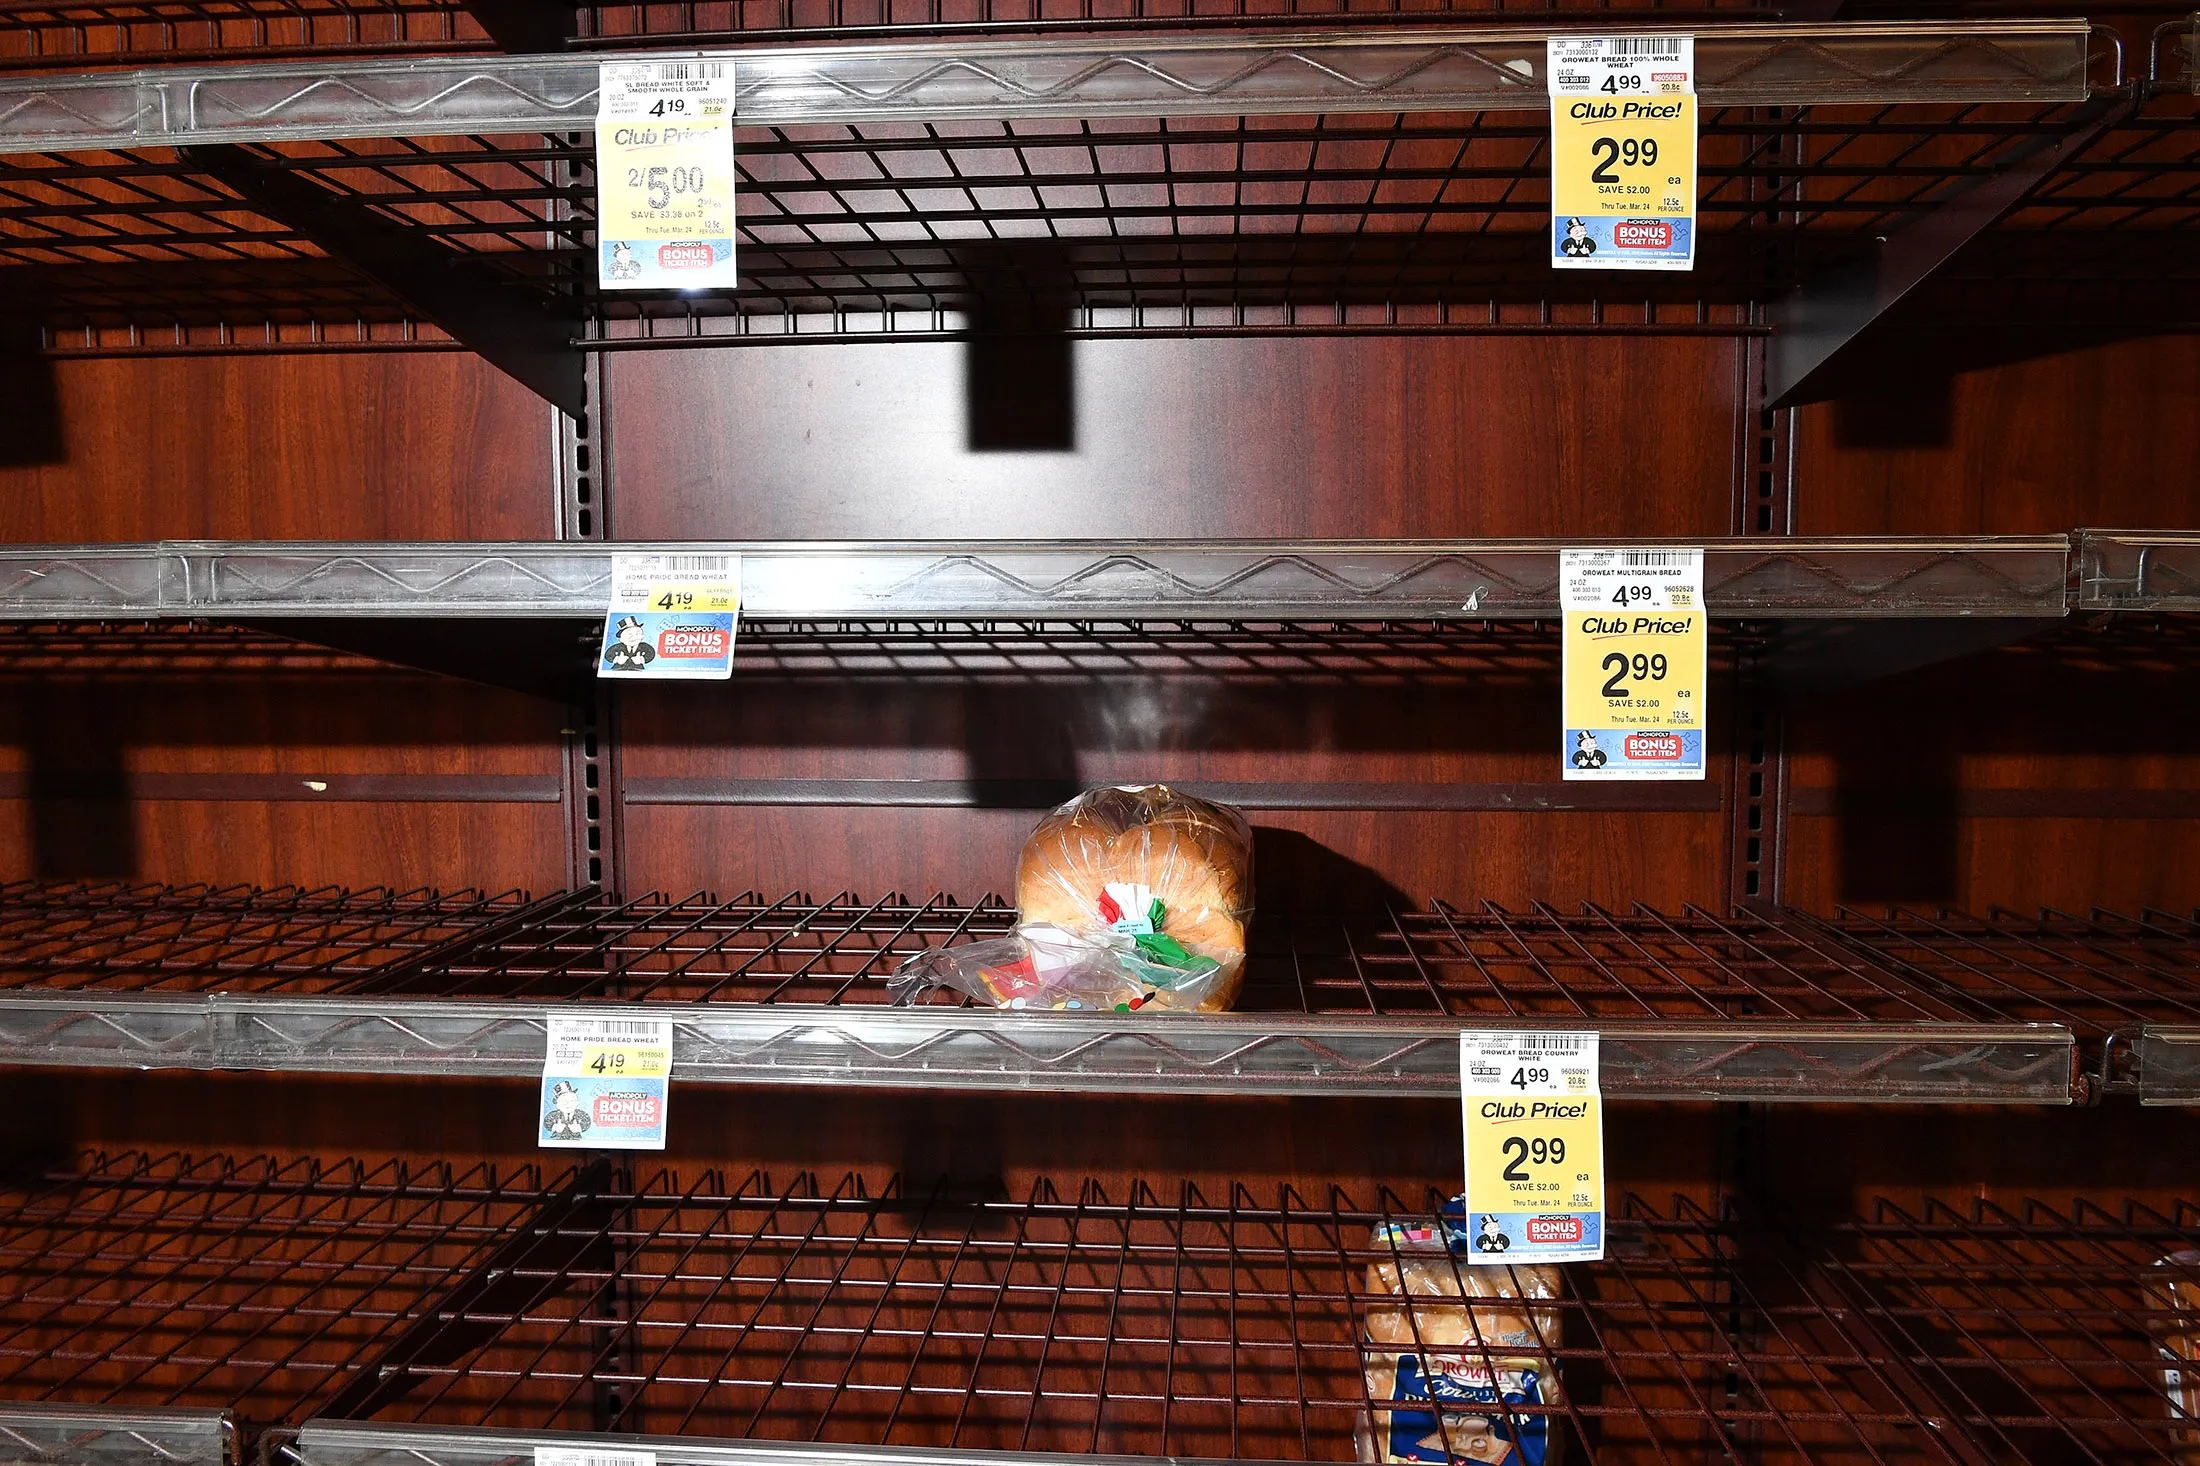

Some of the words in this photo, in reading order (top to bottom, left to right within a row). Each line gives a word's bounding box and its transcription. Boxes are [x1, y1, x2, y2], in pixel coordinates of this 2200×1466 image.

[1600, 75, 1641, 94] 499
[1570, 102, 1617, 118] Club
[1622, 102, 1682, 118] Price!
[615, 129, 657, 145] Club
[1591, 137, 1658, 183] 299
[1668, 177, 1681, 185] ea
[1598, 186, 1624, 194] SAVE
[1627, 186, 1650, 194] $2.00
[1663, 198, 1679, 206] 12.5¢
[1619, 227, 1666, 238] BONUS
[1648, 238, 1666, 246] ITEM
[663, 249, 708, 260] BONUS
[658, 591, 693, 610] 419
[1612, 585, 1652, 607] 499
[1582, 617, 1627, 634] Club
[1633, 617, 1692, 633] Price!
[665, 633, 722, 646] BONUS
[664, 646, 697, 654] TICKET
[698, 646, 721, 654] ITEM
[1602, 652, 1668, 697] 299
[1677, 690, 1691, 698] ea
[1608, 700, 1633, 708] SAVE
[1636, 699, 1660, 708] $2.00
[1630, 740, 1677, 750] BONUS
[591, 1053, 625, 1073] 419
[1510, 1067, 1549, 1090] 499
[600, 1101, 655, 1114] BONUS
[1481, 1102, 1525, 1118] Club
[1531, 1102, 1587, 1118] Price!
[600, 1114, 632, 1122] TICKET
[632, 1114, 654, 1122] ITEM
[1502, 1136, 1565, 1182] 299
[1576, 1173, 1589, 1181] ea
[1510, 1183, 1534, 1191] SAVE
[1537, 1183, 1560, 1191] $2.00
[1572, 1194, 1588, 1202] 12.5¢
[1532, 1222, 1577, 1233] BONUS
